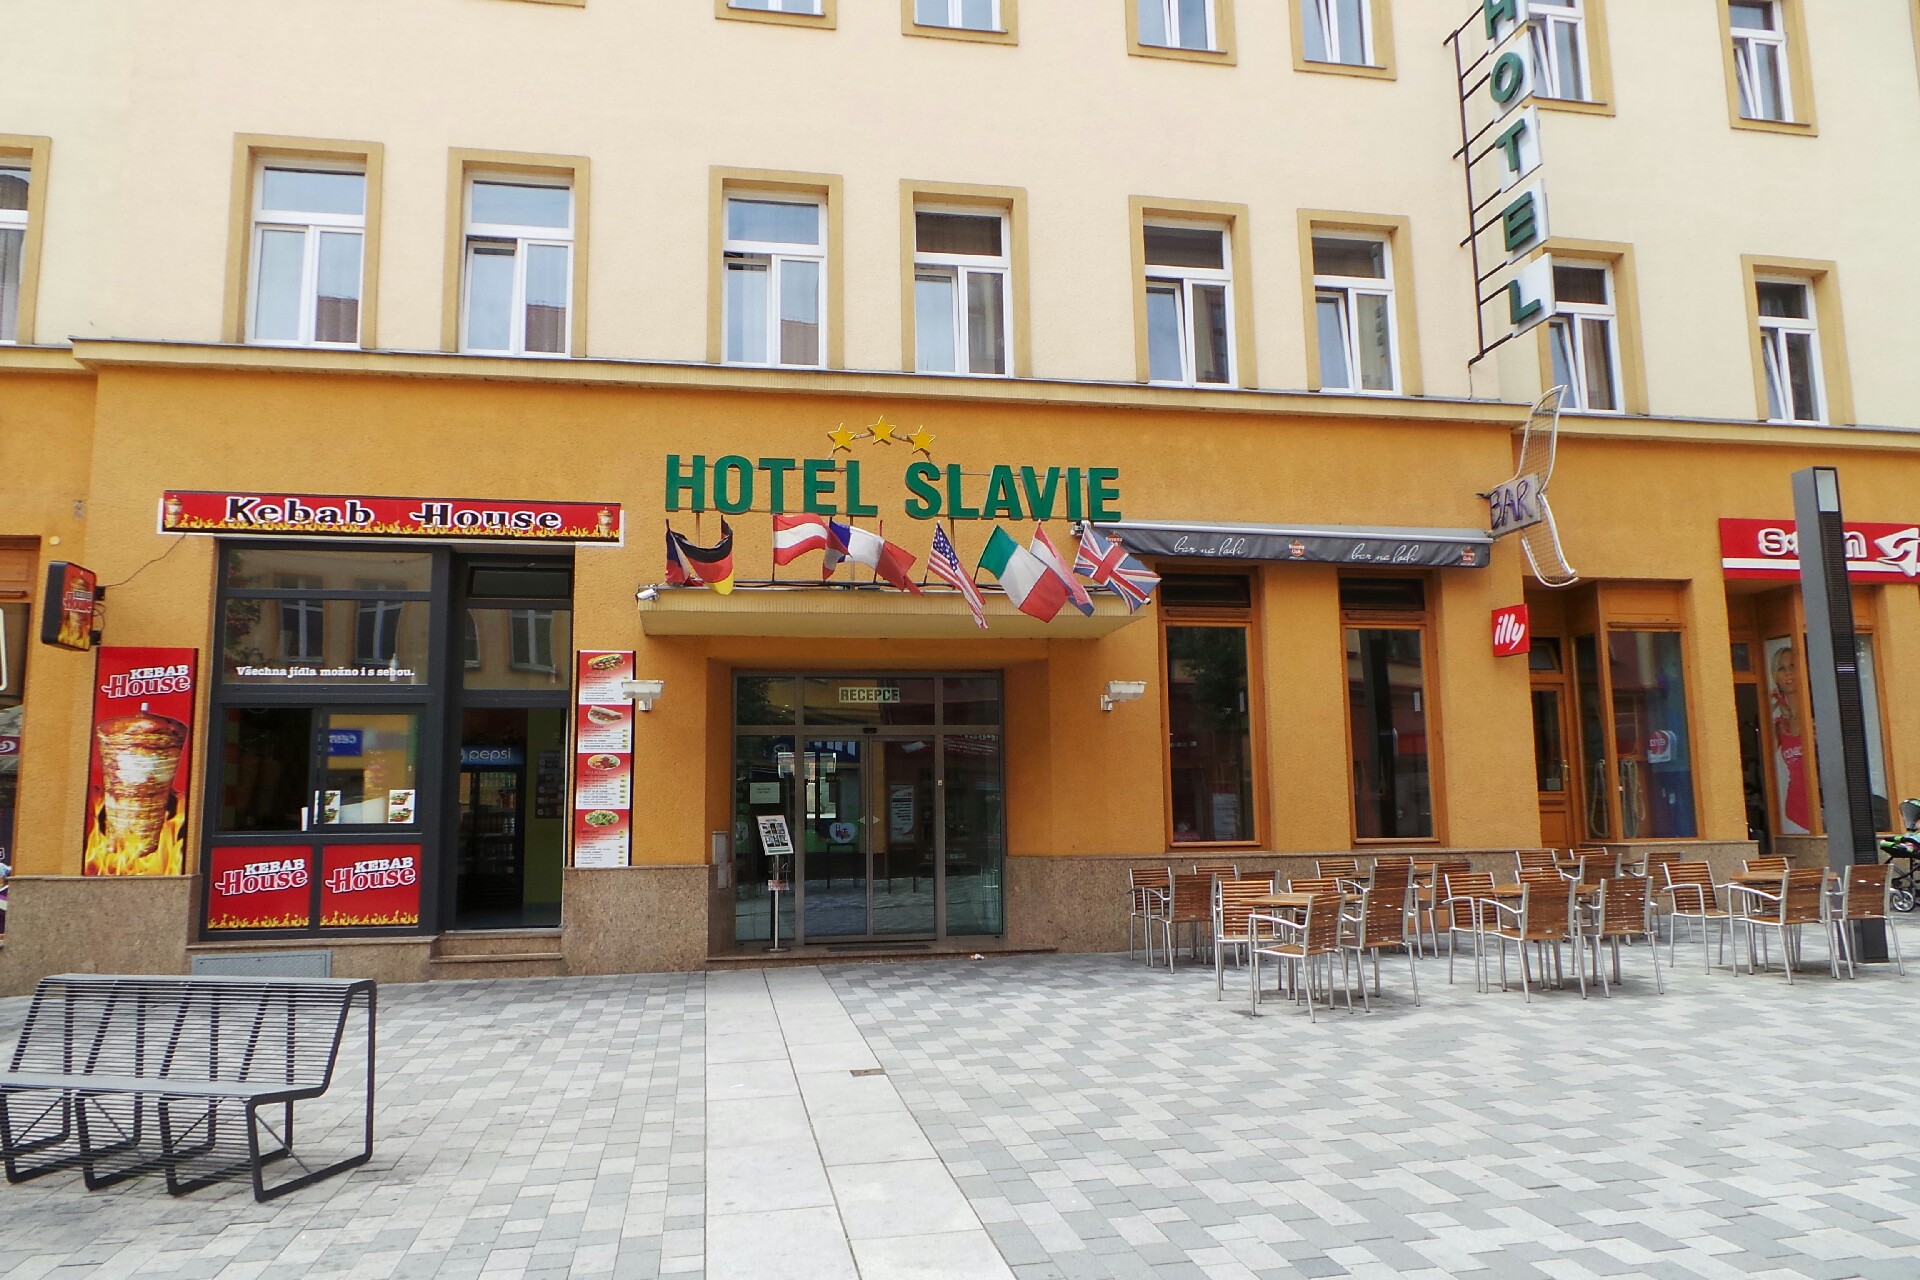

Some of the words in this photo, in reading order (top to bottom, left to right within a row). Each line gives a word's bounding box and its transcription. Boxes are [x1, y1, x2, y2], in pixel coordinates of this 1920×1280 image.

[1482, 0, 1541, 325] HOTEL
[665, 454, 878, 516] HOTEL
[904, 461, 1122, 522] SLAVIE
[225, 496, 375, 526] Kebab
[410, 502, 563, 531] House
[1490, 480, 1533, 531] BAR
[1173, 535, 1197, 553] bar
[1351, 542, 1373, 560] bar
[1494, 613, 1526, 651] illy
[129, 664, 189, 681] KEBAB
[235, 666, 287, 677] Všechna
[287, 666, 317, 679] jídla
[319, 665, 358, 677] možno
[360, 666, 366, 677] i
[367, 669, 375, 677] s
[377, 666, 415, 677] sebou.
[101, 674, 191, 699] House
[840, 688, 899, 701] RECEPCE
[468, 747, 511, 762] pepsi
[244, 858, 305, 876] KEBAB
[354, 856, 414, 875] KEBAB
[214, 869, 308, 896] House
[325, 867, 416, 894] House
